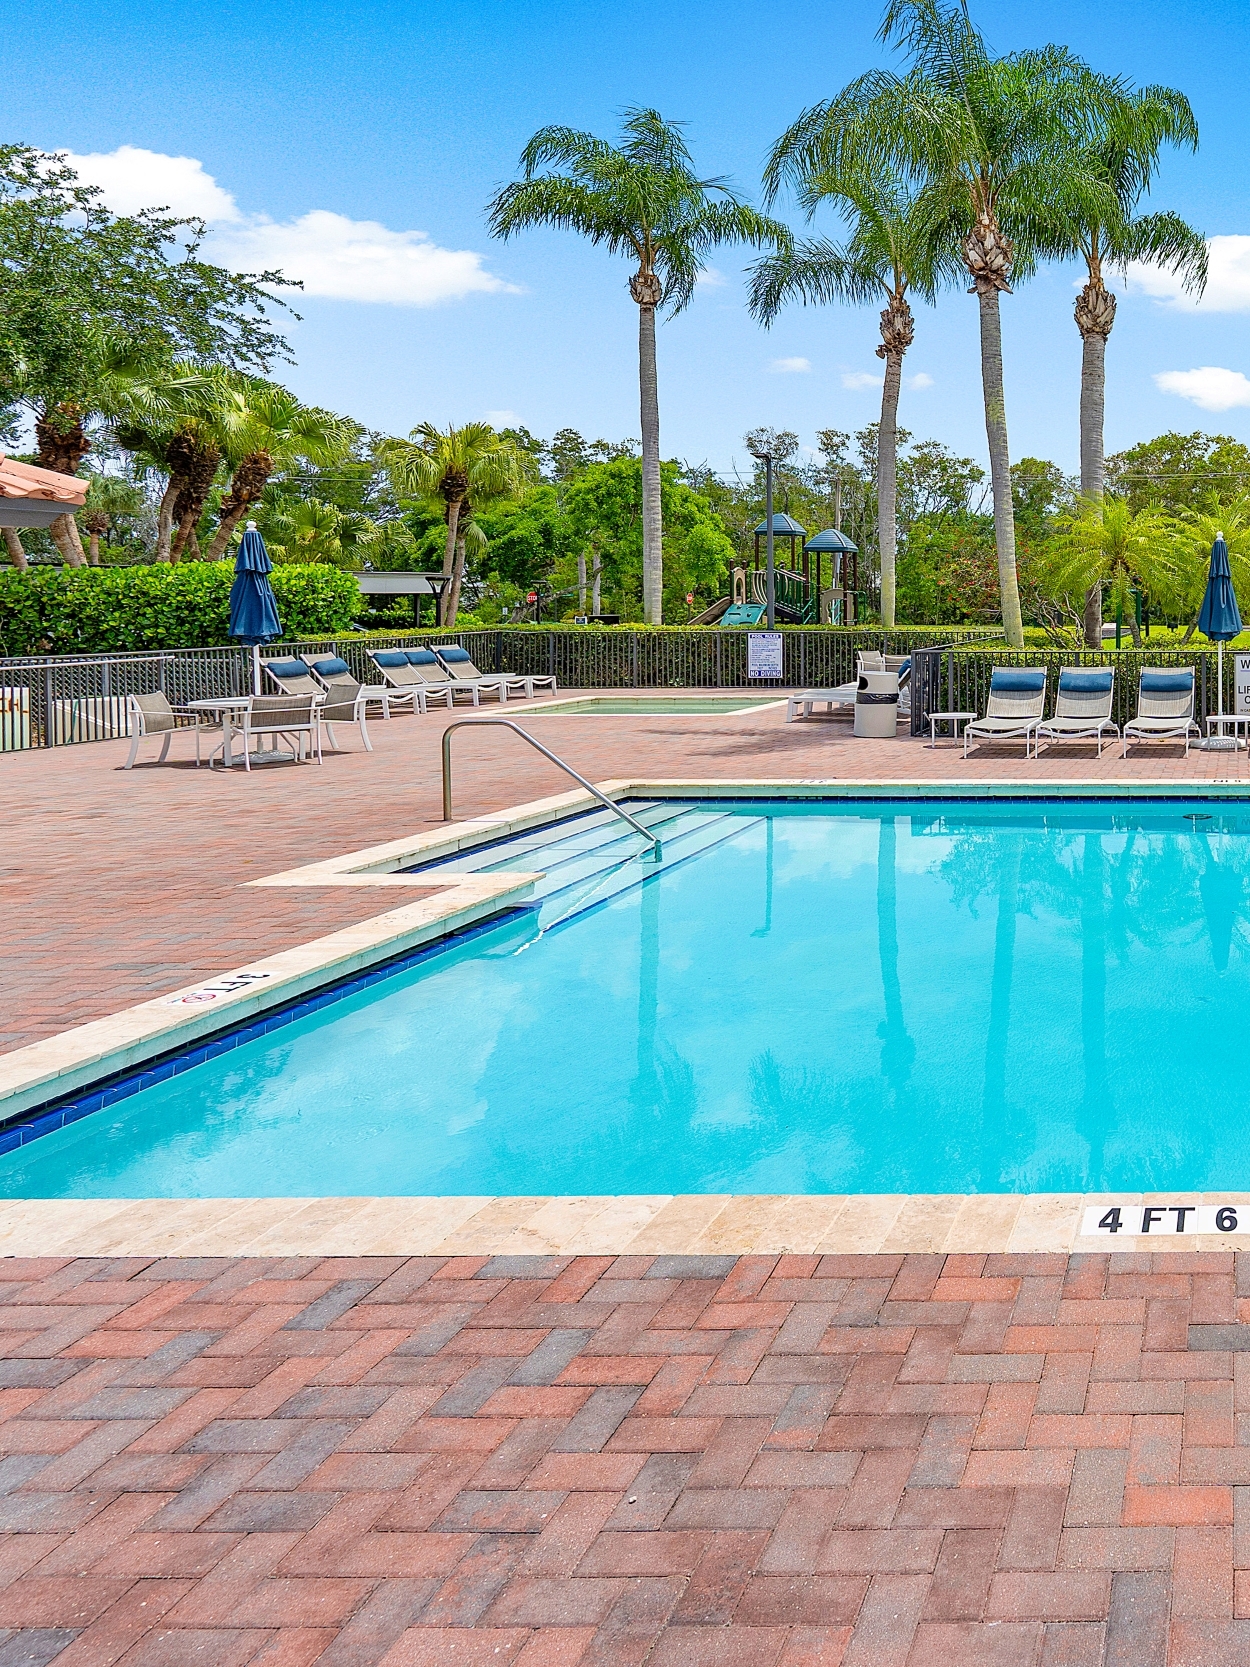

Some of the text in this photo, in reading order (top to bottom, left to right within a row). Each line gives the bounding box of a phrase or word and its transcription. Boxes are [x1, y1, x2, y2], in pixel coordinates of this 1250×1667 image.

[203, 981, 253, 993] FT
[1098, 1206, 1123, 1233] 4
[1141, 1206, 1196, 1233] FT
[1215, 1206, 1238, 1232] 6
